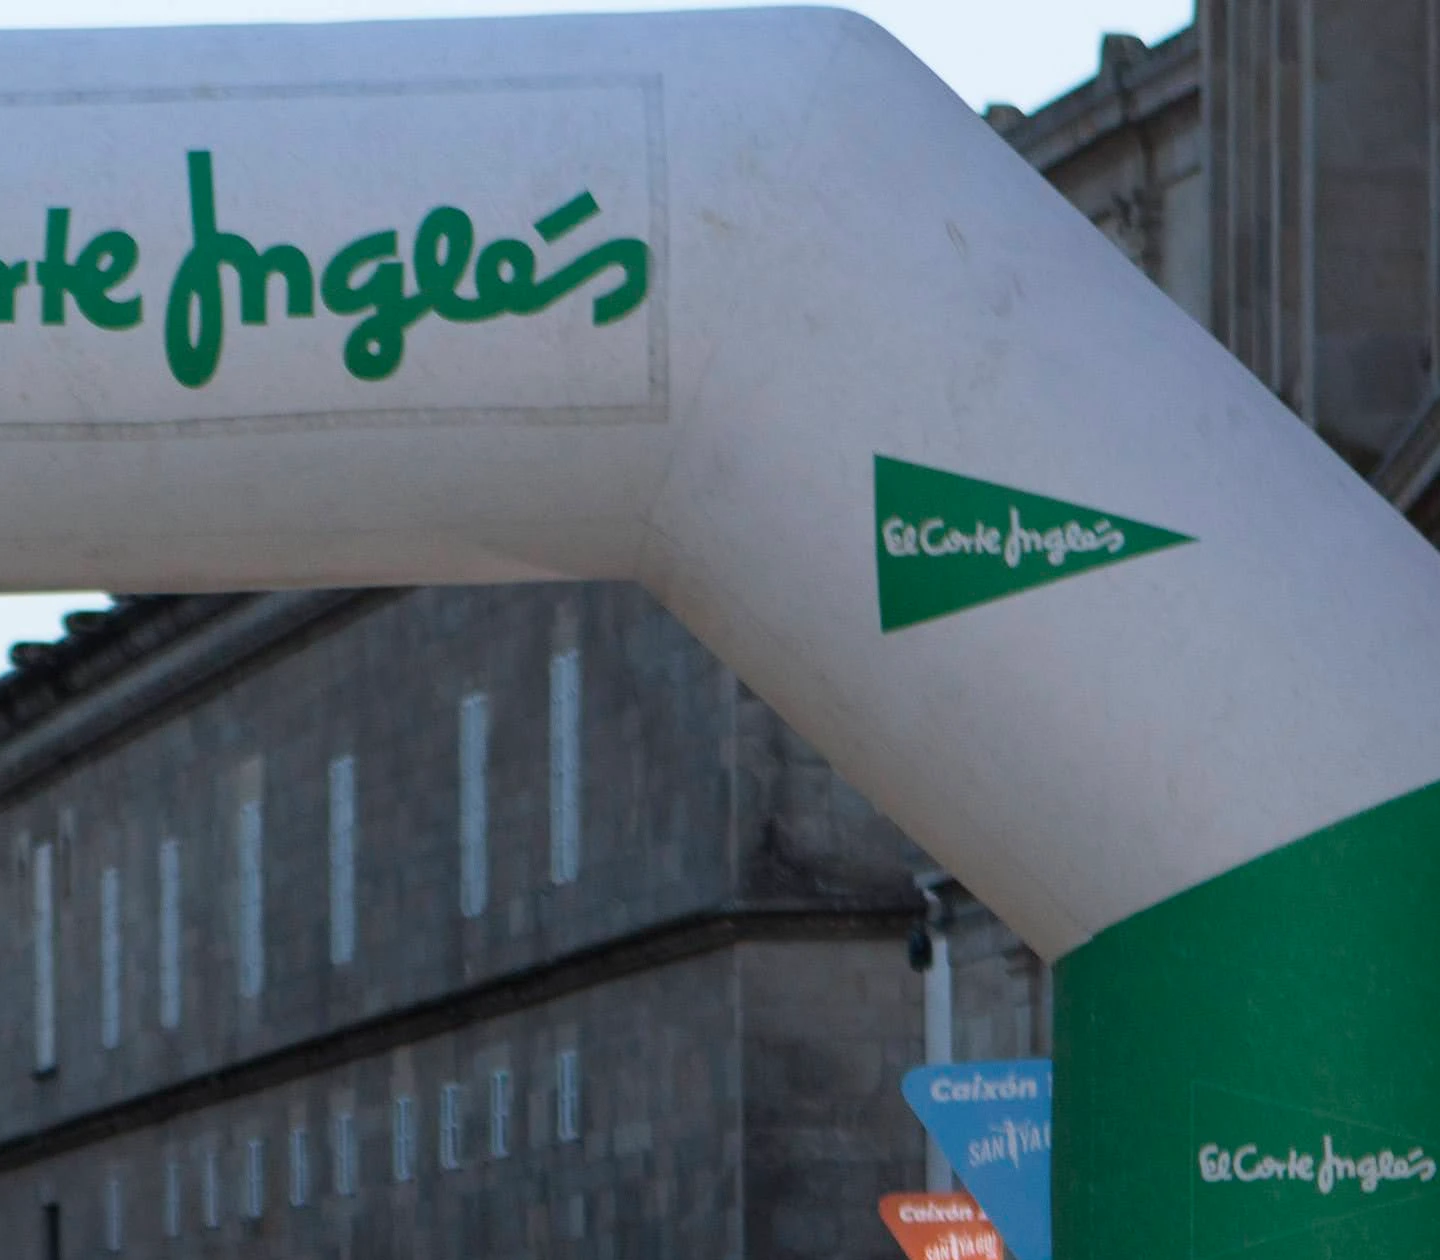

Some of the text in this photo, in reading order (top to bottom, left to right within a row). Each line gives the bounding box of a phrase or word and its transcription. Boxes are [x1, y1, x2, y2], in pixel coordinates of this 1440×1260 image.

[163, 149, 649, 389] Inglés
[881, 504, 1126, 569] El Corte Inglés
[930, 1071, 1038, 1103] Caixón
[1199, 1133, 1437, 1195] El Corte Inglés
